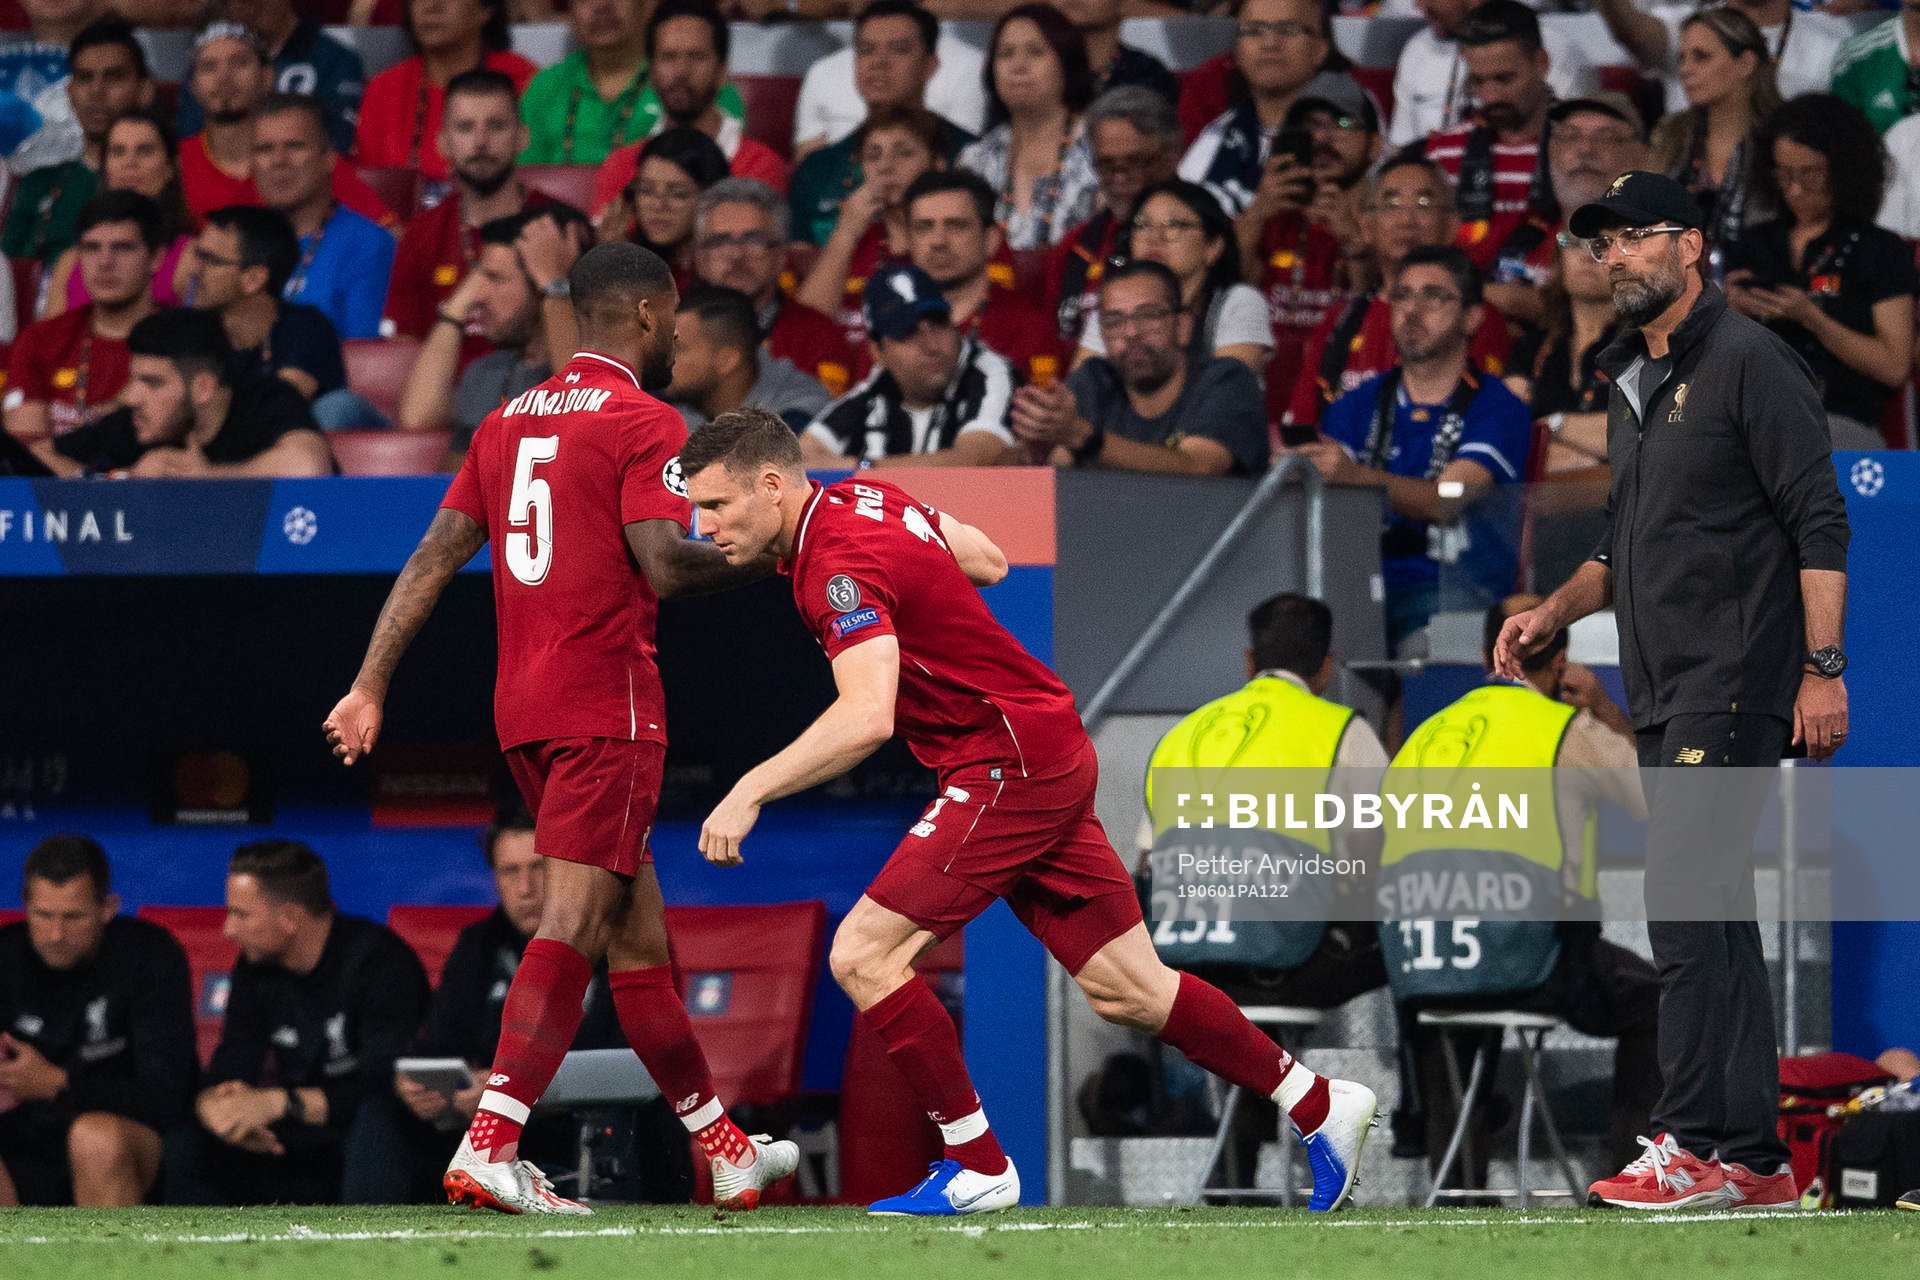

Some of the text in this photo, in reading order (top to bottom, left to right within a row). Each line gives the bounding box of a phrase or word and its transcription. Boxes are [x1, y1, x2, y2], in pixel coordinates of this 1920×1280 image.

[0, 510, 134, 541] FINAL
[505, 434, 560, 586] 5
[840, 590, 850, 602] 5
[840, 610, 878, 629] RESPECT
[1151, 889, 1237, 944] 251
